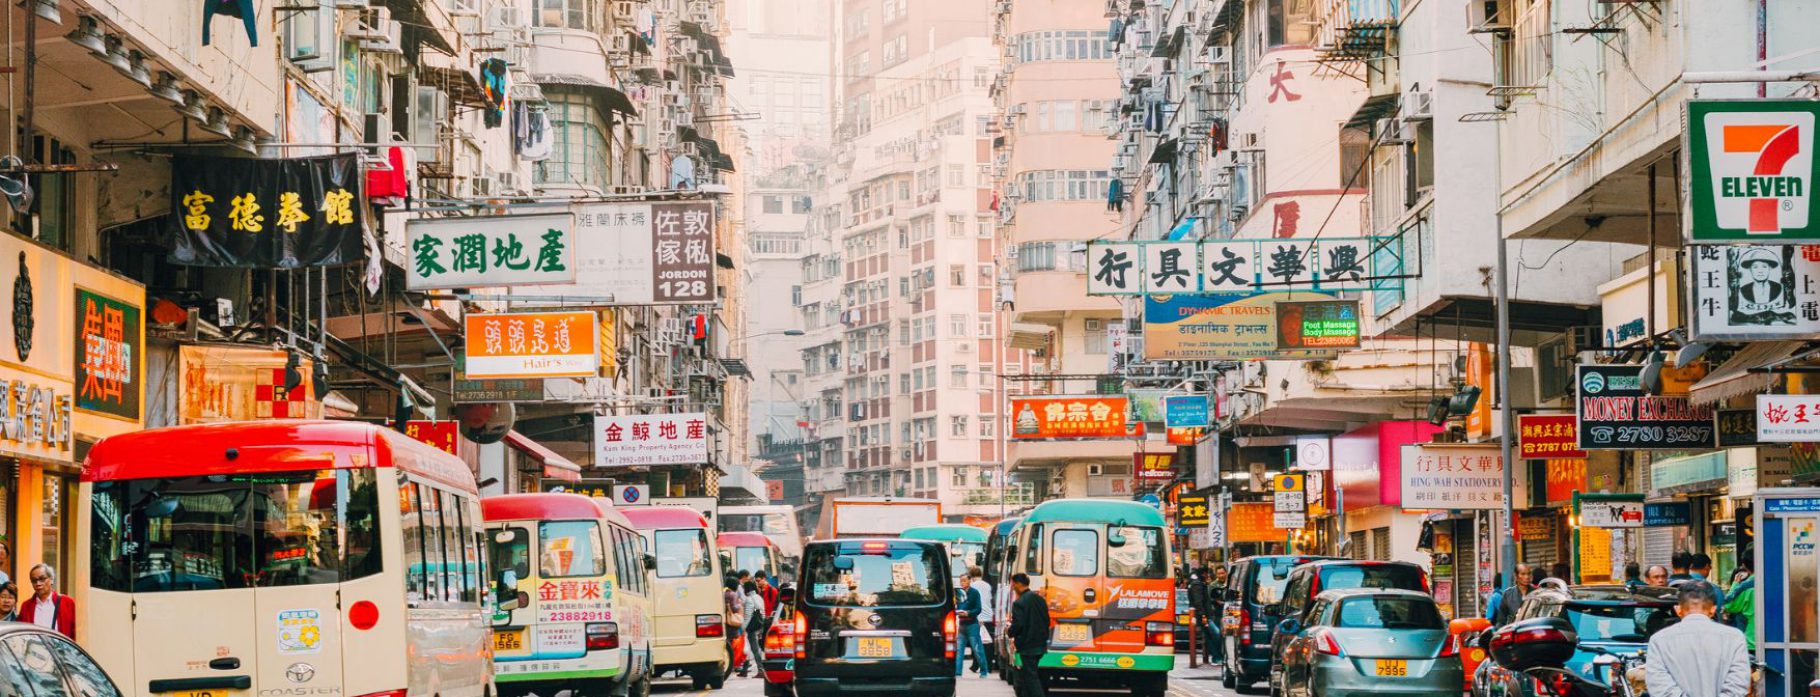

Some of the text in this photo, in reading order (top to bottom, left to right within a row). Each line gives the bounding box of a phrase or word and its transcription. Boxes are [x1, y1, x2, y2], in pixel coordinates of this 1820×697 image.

[182, 190, 354, 233] 富德拳館
[655, 210, 710, 236] 佐敦
[412, 228, 567, 278] 家潤地產
[658, 270, 707, 279] JORDON
[658, 281, 707, 297] 128
[1178, 306, 1270, 316] DYNAMIC TRAVELS
[1304, 321, 1320, 329] Foot
[1304, 329, 1322, 338] Body
[1583, 397, 1635, 421] MONEY
[1617, 426, 1712, 442] 2780 3287
[639, 443, 667, 451] Property
[1537, 443, 1560, 452] 2787
[1411, 477, 1430, 487] HING
[1434, 477, 1452, 487] WAH
[1455, 477, 1502, 487] STATIONERY
[1119, 590, 1169, 598] LALAMOVE
[550, 612, 612, 621] 23882918
[259, 687, 341, 697] COASTER
